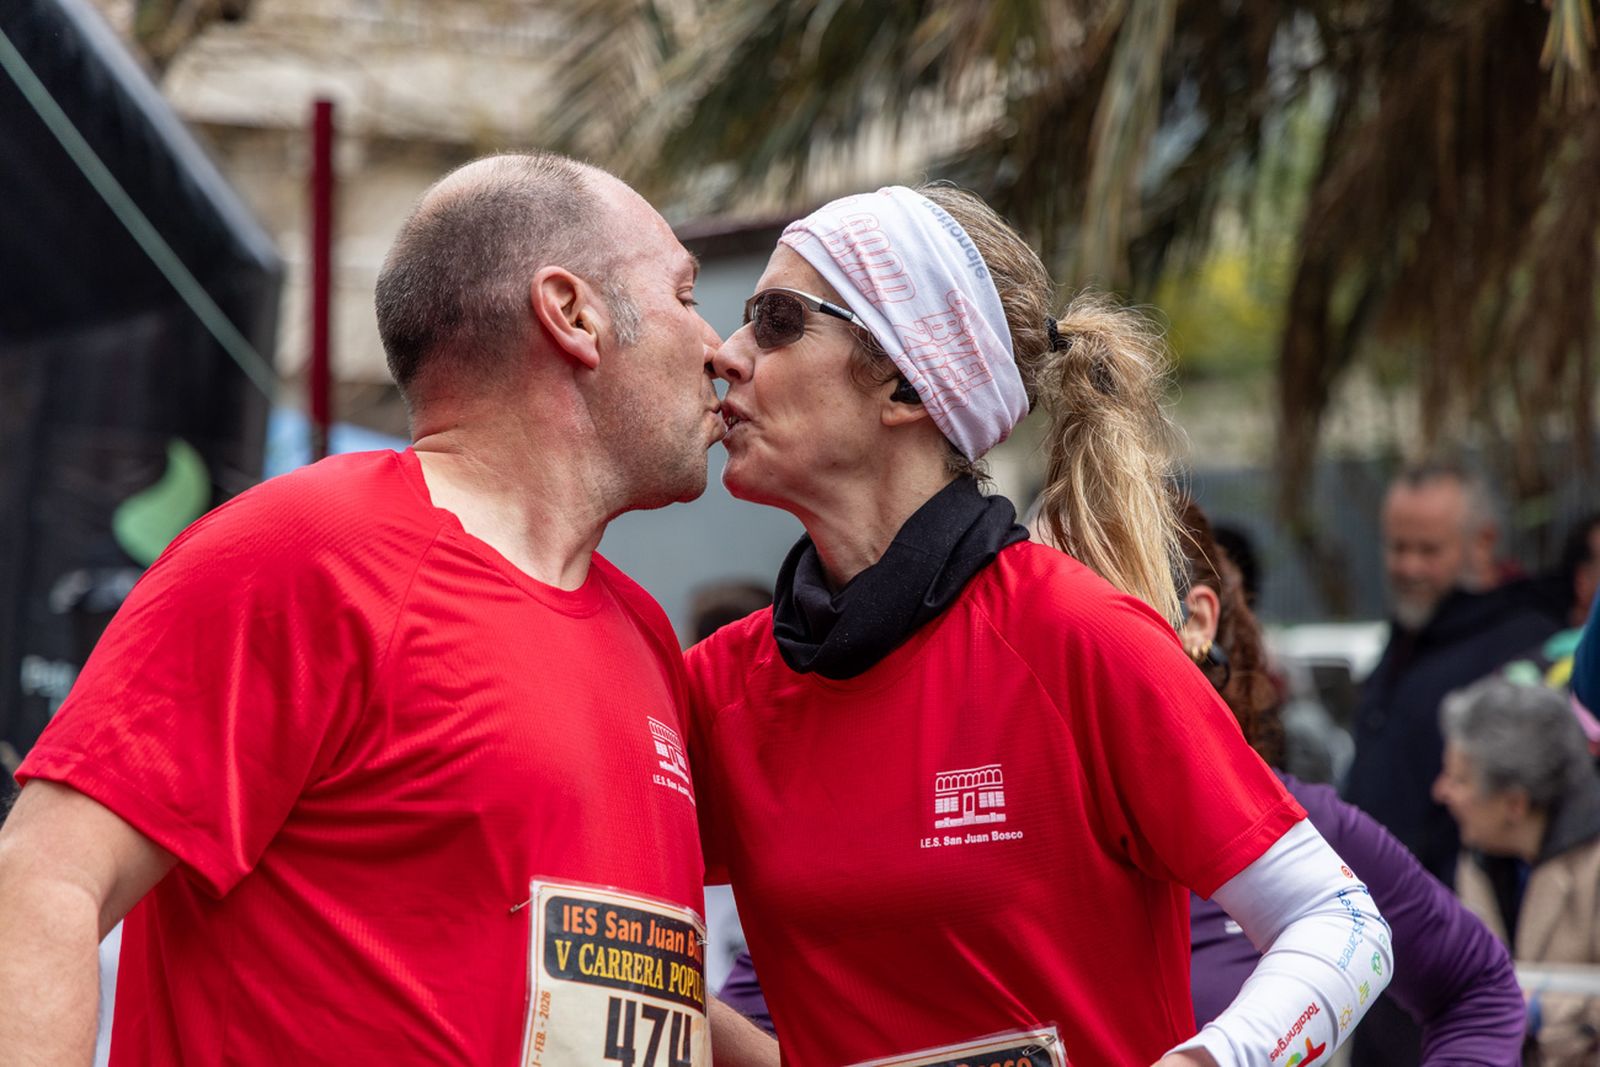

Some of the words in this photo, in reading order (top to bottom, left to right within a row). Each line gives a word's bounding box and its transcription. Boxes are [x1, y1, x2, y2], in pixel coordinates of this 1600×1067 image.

[840, 211, 916, 303] GOOD
[920, 837, 942, 849] I.E.S.
[943, 835, 962, 846] San
[964, 833, 989, 844] Juan
[991, 830, 1024, 841] Bosco
[562, 904, 598, 936] IES
[605, 910, 642, 944] San
[646, 919, 685, 954] Juan
[554, 939, 572, 971] V
[578, 943, 664, 990] CARRERA
[539, 990, 551, 1019] 2026
[603, 995, 692, 1067] 474
[1269, 1001, 1321, 1062] TotalEnergies
